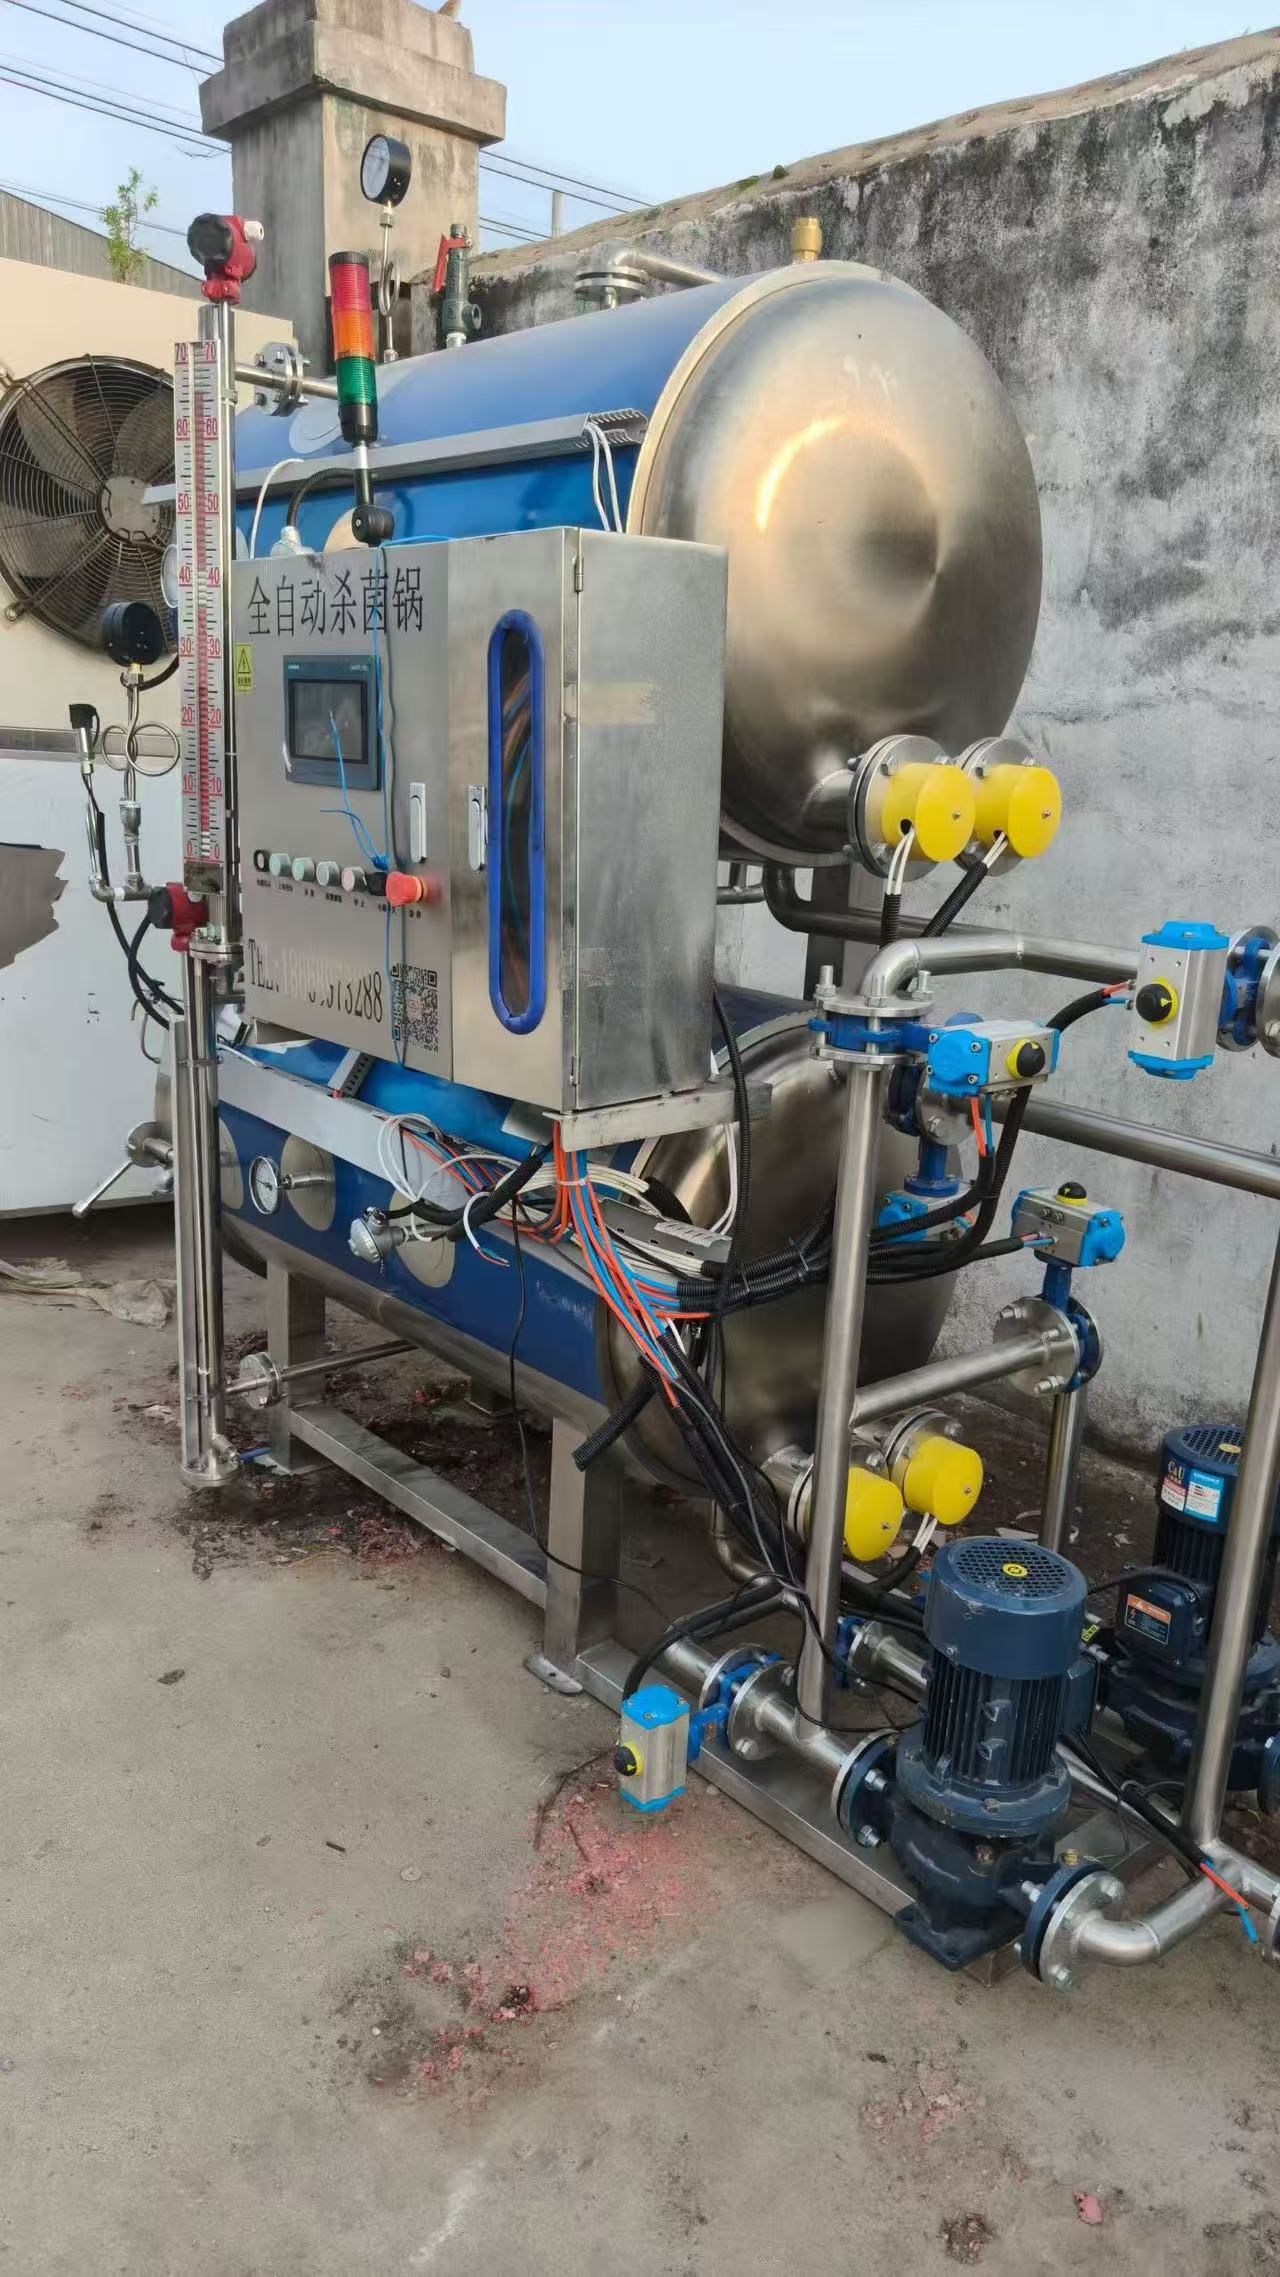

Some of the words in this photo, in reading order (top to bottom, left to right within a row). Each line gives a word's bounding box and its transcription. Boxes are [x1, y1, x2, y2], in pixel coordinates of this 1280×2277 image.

[175, 344, 187, 361] 70
[204, 343, 217, 360] 70
[176, 418, 188, 436] 60
[206, 418, 218, 435] 60
[178, 493, 189, 511] 50
[207, 493, 218, 511] 50
[179, 566, 190, 583] 40
[208, 567, 220, 584] 40
[248, 567, 424, 636] 全自动杀菌锅
[180, 637, 192, 654] 30
[209, 638, 220, 655] 30
[181, 705, 193, 722] 20
[210, 707, 221, 725] 20
[183, 774, 194, 791] 10
[211, 776, 222, 793] 10
[187, 841, 193, 857] 0
[214, 843, 220, 859] 0
